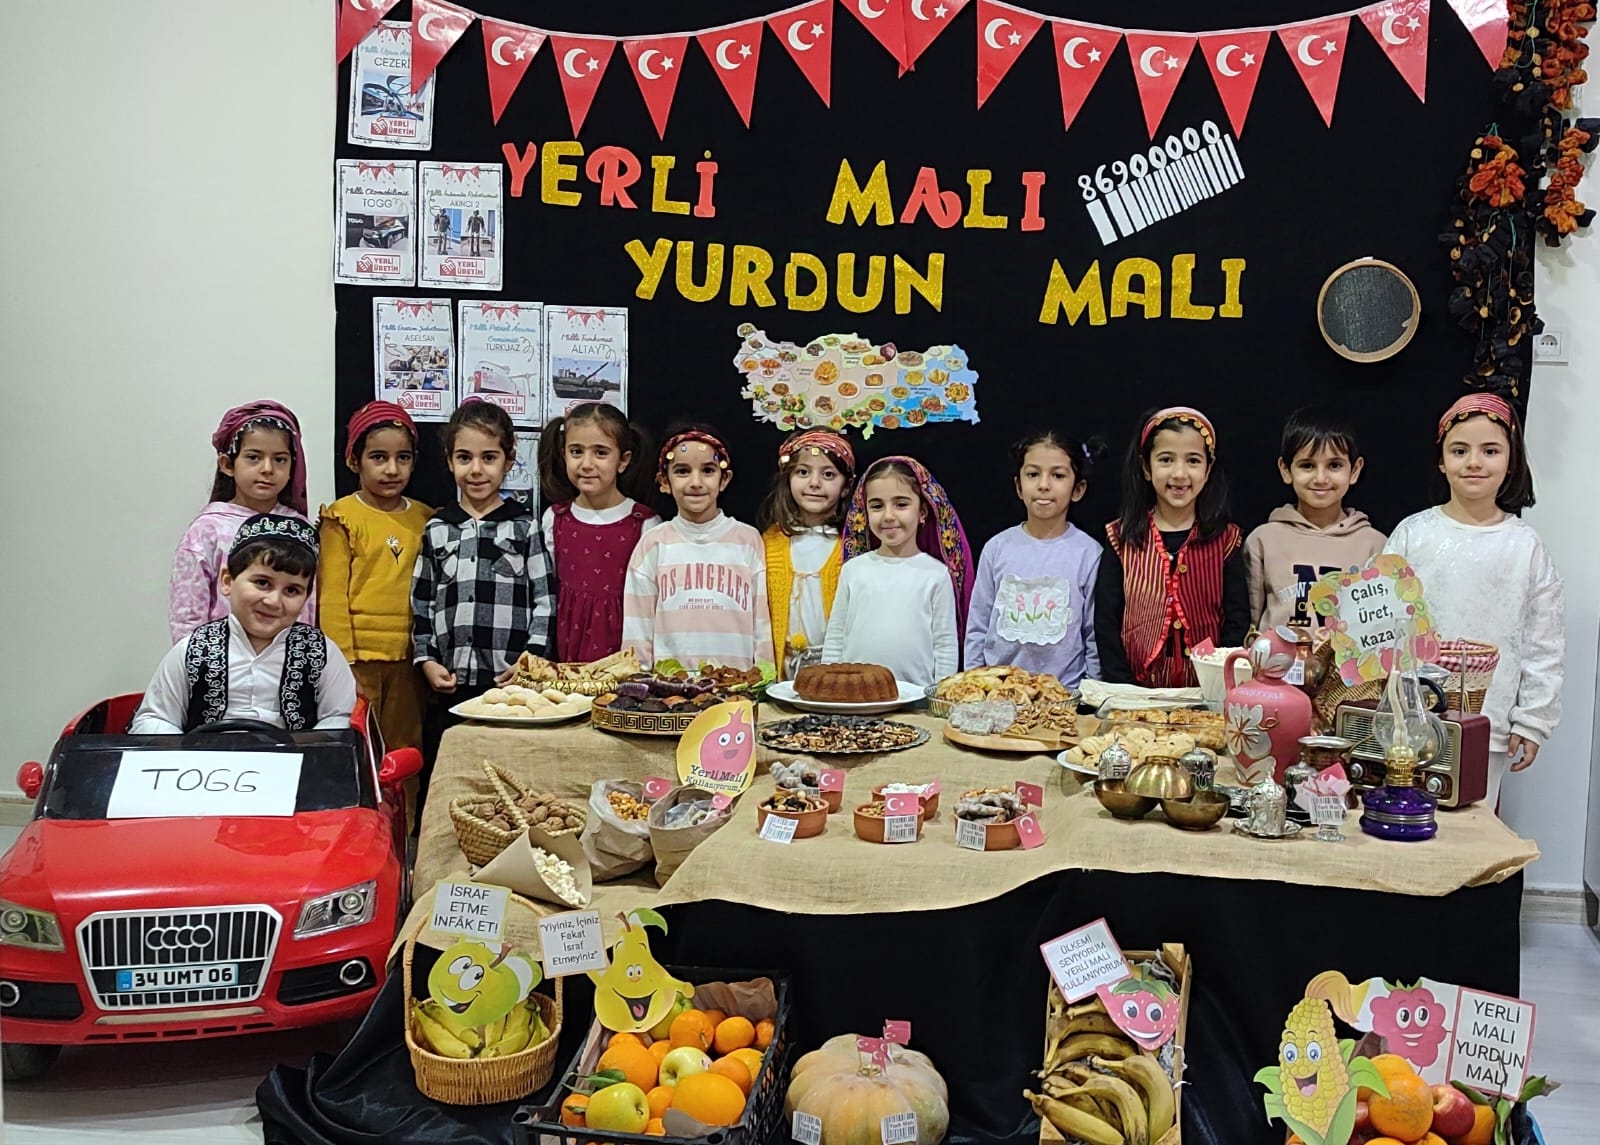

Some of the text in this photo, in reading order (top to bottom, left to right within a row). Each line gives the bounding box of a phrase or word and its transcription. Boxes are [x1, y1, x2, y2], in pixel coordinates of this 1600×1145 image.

[388, 119, 409, 128] YERLİ
[388, 127, 414, 136] ÜRETİM
[1078, 120, 1220, 201] 86900000
[502, 141, 1046, 231] YERLİ MALI
[362, 198, 393, 209] TOGG
[373, 256, 394, 265] YERLİ
[373, 264, 399, 273] ÜRETİM
[457, 260, 478, 268] YERLİ
[457, 267, 484, 276] ÜRETİM
[624, 237, 1246, 326] YURDUN MALI
[404, 334, 435, 342] ASELSAN
[486, 343, 521, 352] TURKUAZ
[571, 344, 601, 354] ALTAY
[415, 400, 440, 408] ÜRETİM
[498, 397, 518, 405] YERLİ
[660, 563, 749, 611] OS ANGELES
[1351, 583, 1388, 604] Çalış,
[1358, 604, 1393, 624] Üret,
[141, 768, 260, 793] TOGG
[691, 765, 719, 780] Yerli
[450, 883, 491, 900] İSRAF
[450, 901, 489, 916] ETME
[560, 930, 586, 941] Fakat
[1061, 933, 1092, 955] ÜLKEMİ
[563, 941, 584, 952] İsraf
[1058, 941, 1106, 968] SEVİYORUM
[135, 972, 158, 987] 34
[163, 969, 203, 985] UMT
[208, 968, 232, 983] 06
[1063, 957, 1124, 991] KULLANIYORUM
[1064, 960, 1090, 978] YERLİ
[1474, 999, 1520, 1024] YERLİ
[1472, 1022, 1515, 1045] MALI
[1456, 1039, 1525, 1069] YURDUN
[1466, 1063, 1508, 1087] MALI
